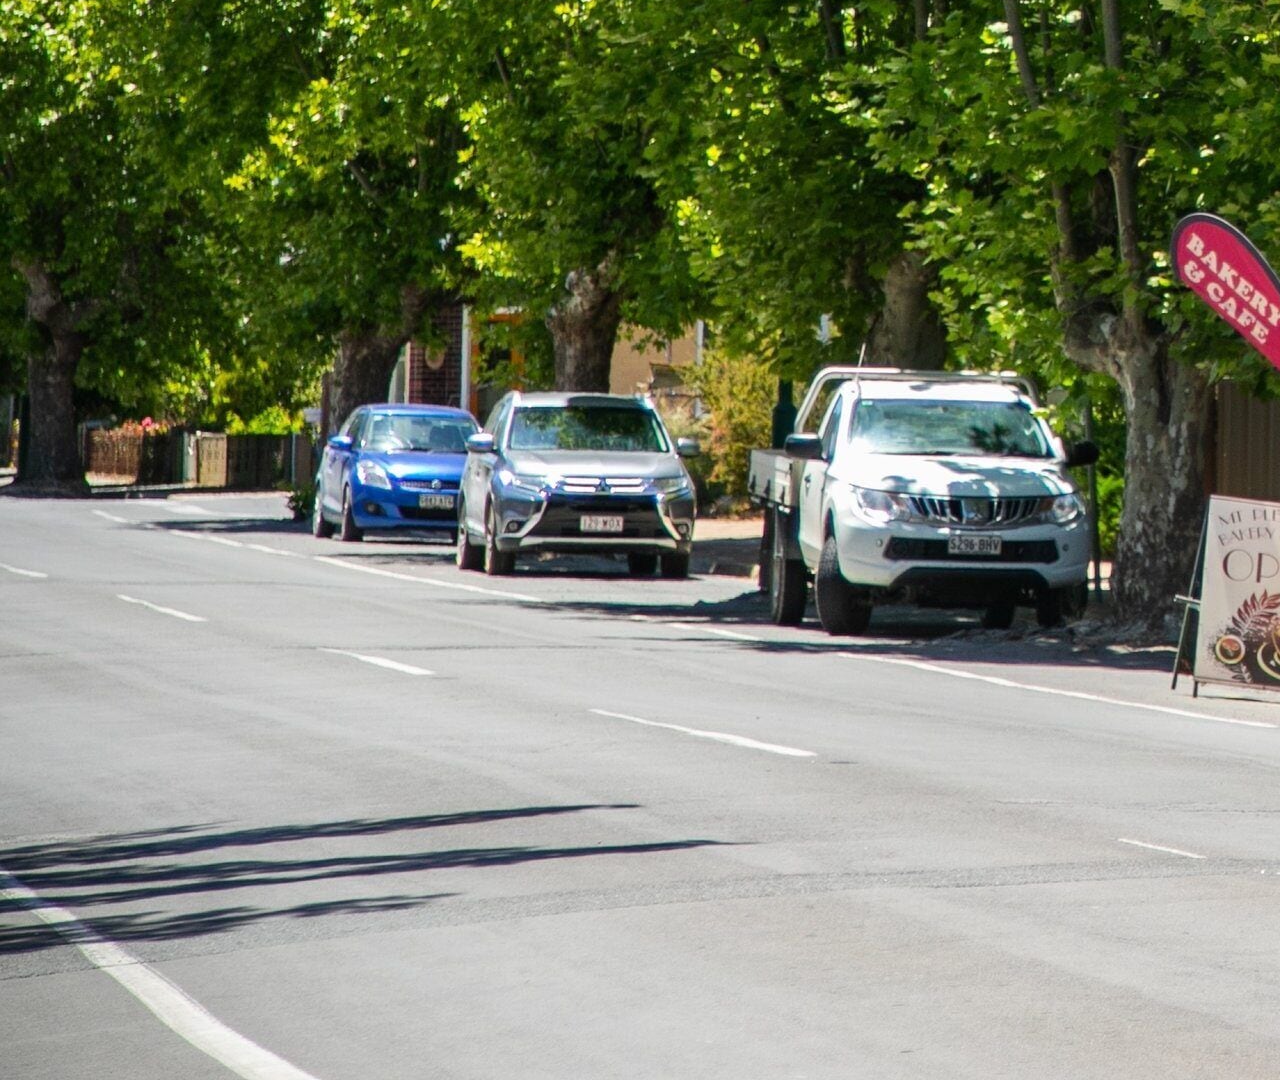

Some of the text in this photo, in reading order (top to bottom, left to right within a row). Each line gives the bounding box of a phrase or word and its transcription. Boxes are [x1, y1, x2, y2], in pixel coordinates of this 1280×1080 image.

[1184, 260, 1269, 344] & CAFE
[1217, 526, 1274, 547] BAKERY
